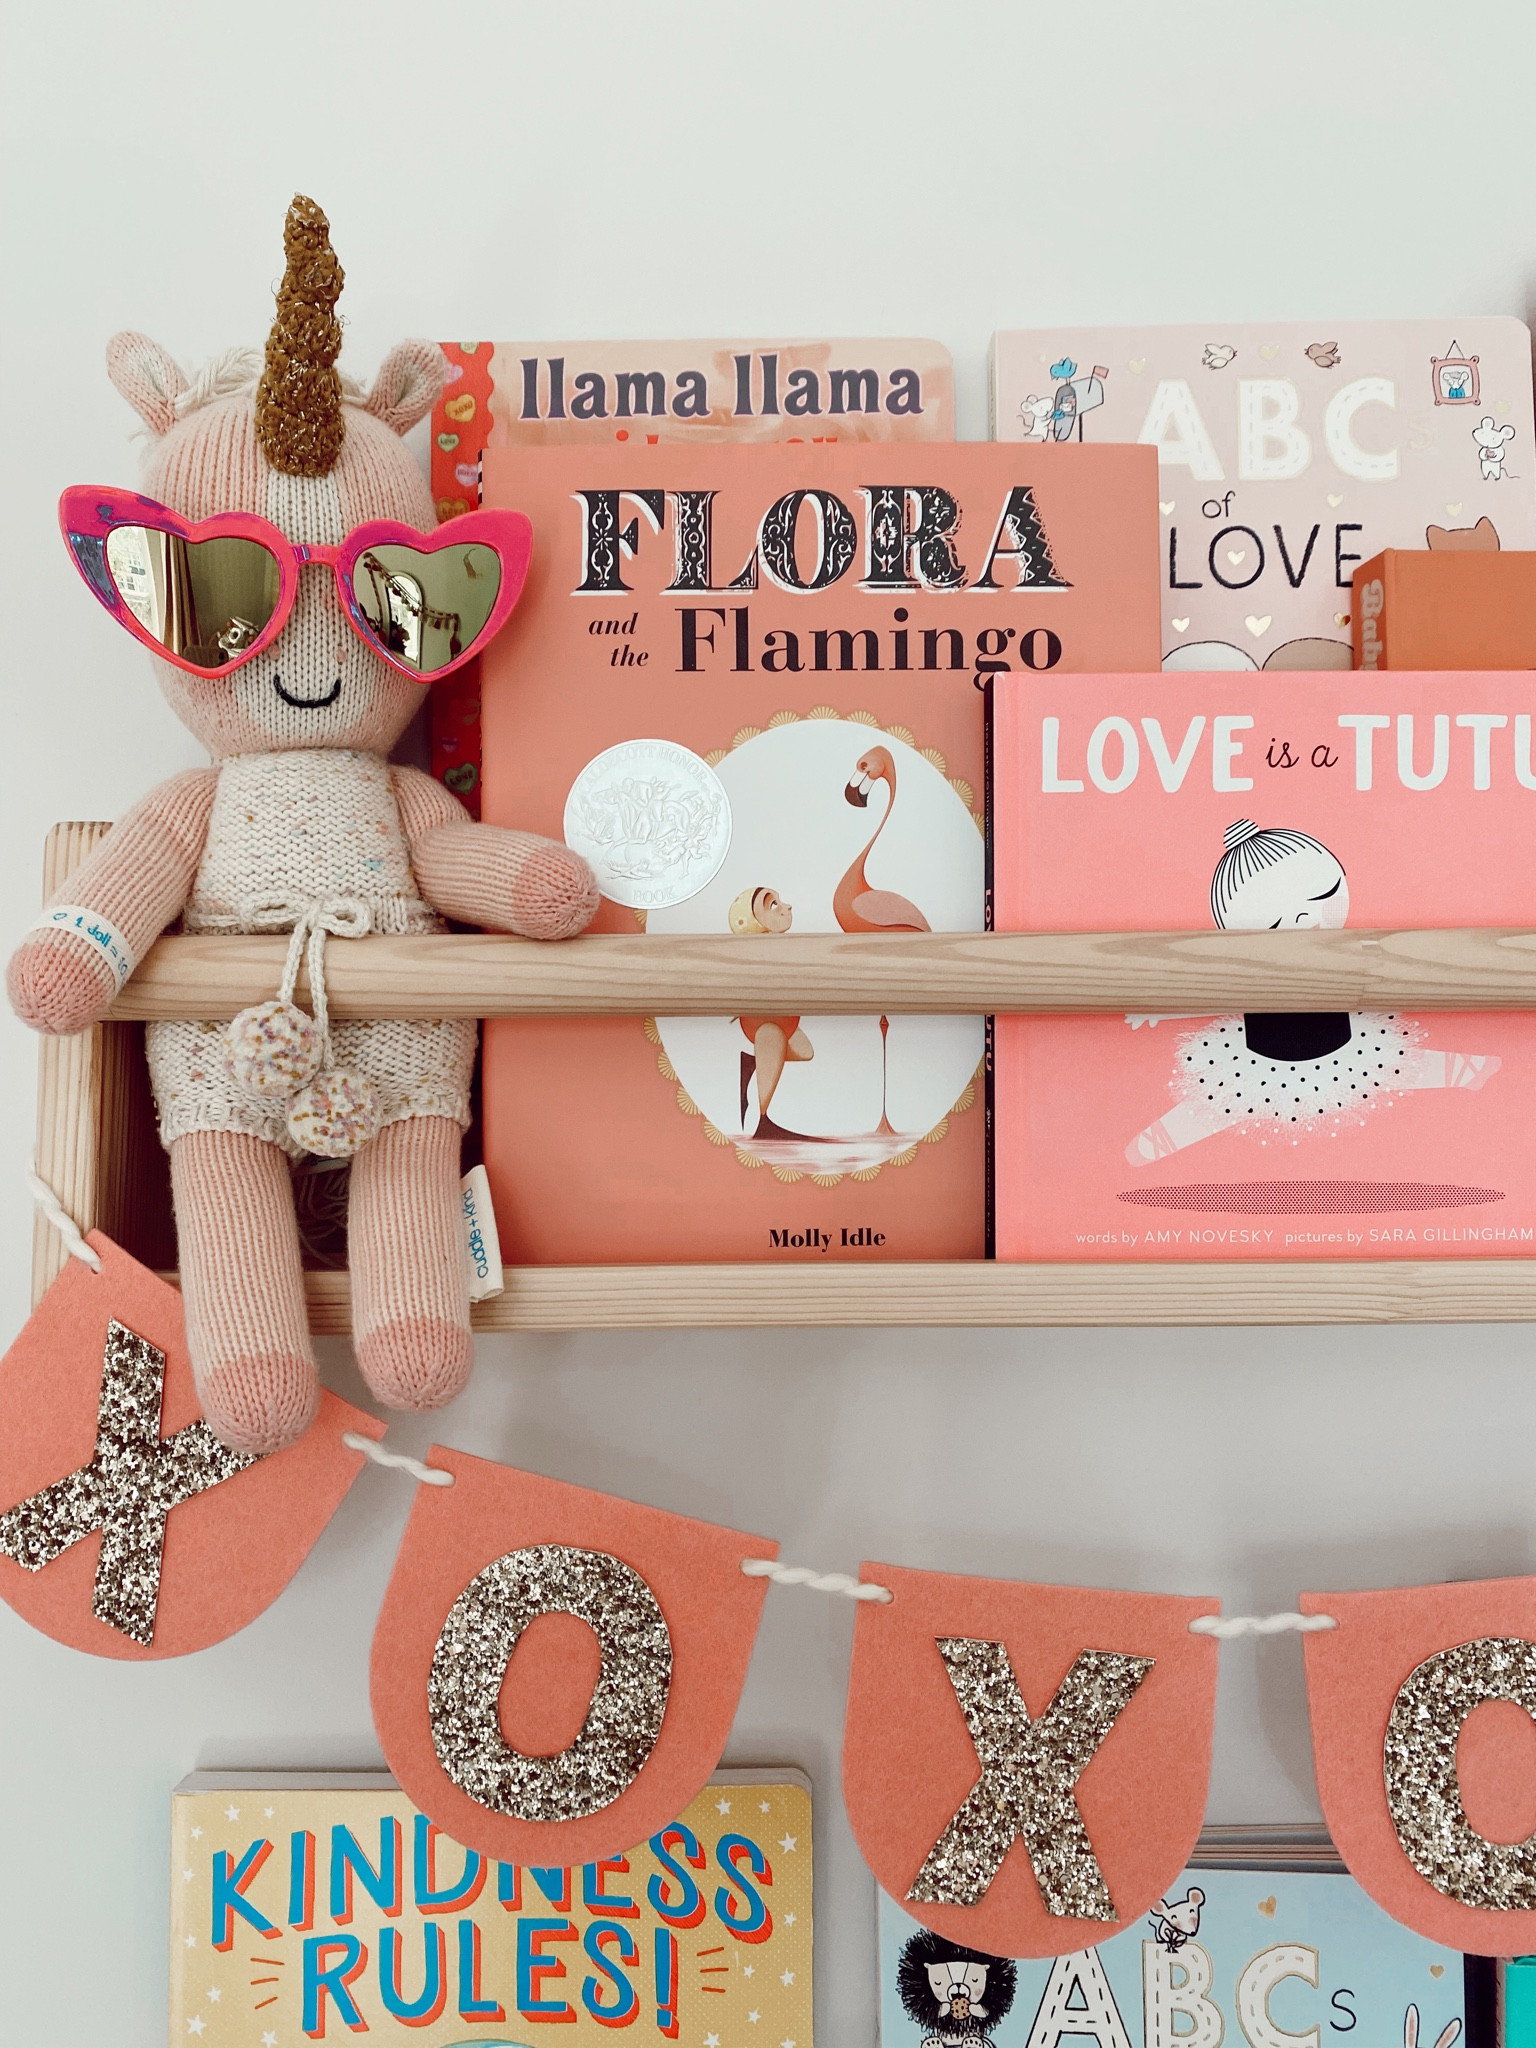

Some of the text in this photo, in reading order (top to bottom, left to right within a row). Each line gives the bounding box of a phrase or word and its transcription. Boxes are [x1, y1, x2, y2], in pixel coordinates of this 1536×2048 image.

[518, 353, 924, 421] llama llama
[1201, 491, 1236, 519] of
[569, 485, 1074, 597] FLORA
[1169, 524, 1364, 589] LOVE
[588, 612, 638, 637] and
[673, 606, 1064, 691] Flamingo
[1359, 578, 1384, 670] Bab
[610, 644, 649, 668] the
[659, 746, 709, 784] HONOR
[1041, 715, 1255, 794] LOVE
[1265, 737, 1300, 769] is
[1311, 744, 1339, 768] a
[633, 885, 676, 903] BOOK
[468, 1228, 489, 1279] cuddle
[768, 1227, 886, 1252] Molly Idle
[1075, 1227, 1534, 1246] words by AMY NOVESKY pictures by SARA GILLINGHAM
[302, 1918, 680, 2041] RULES!
